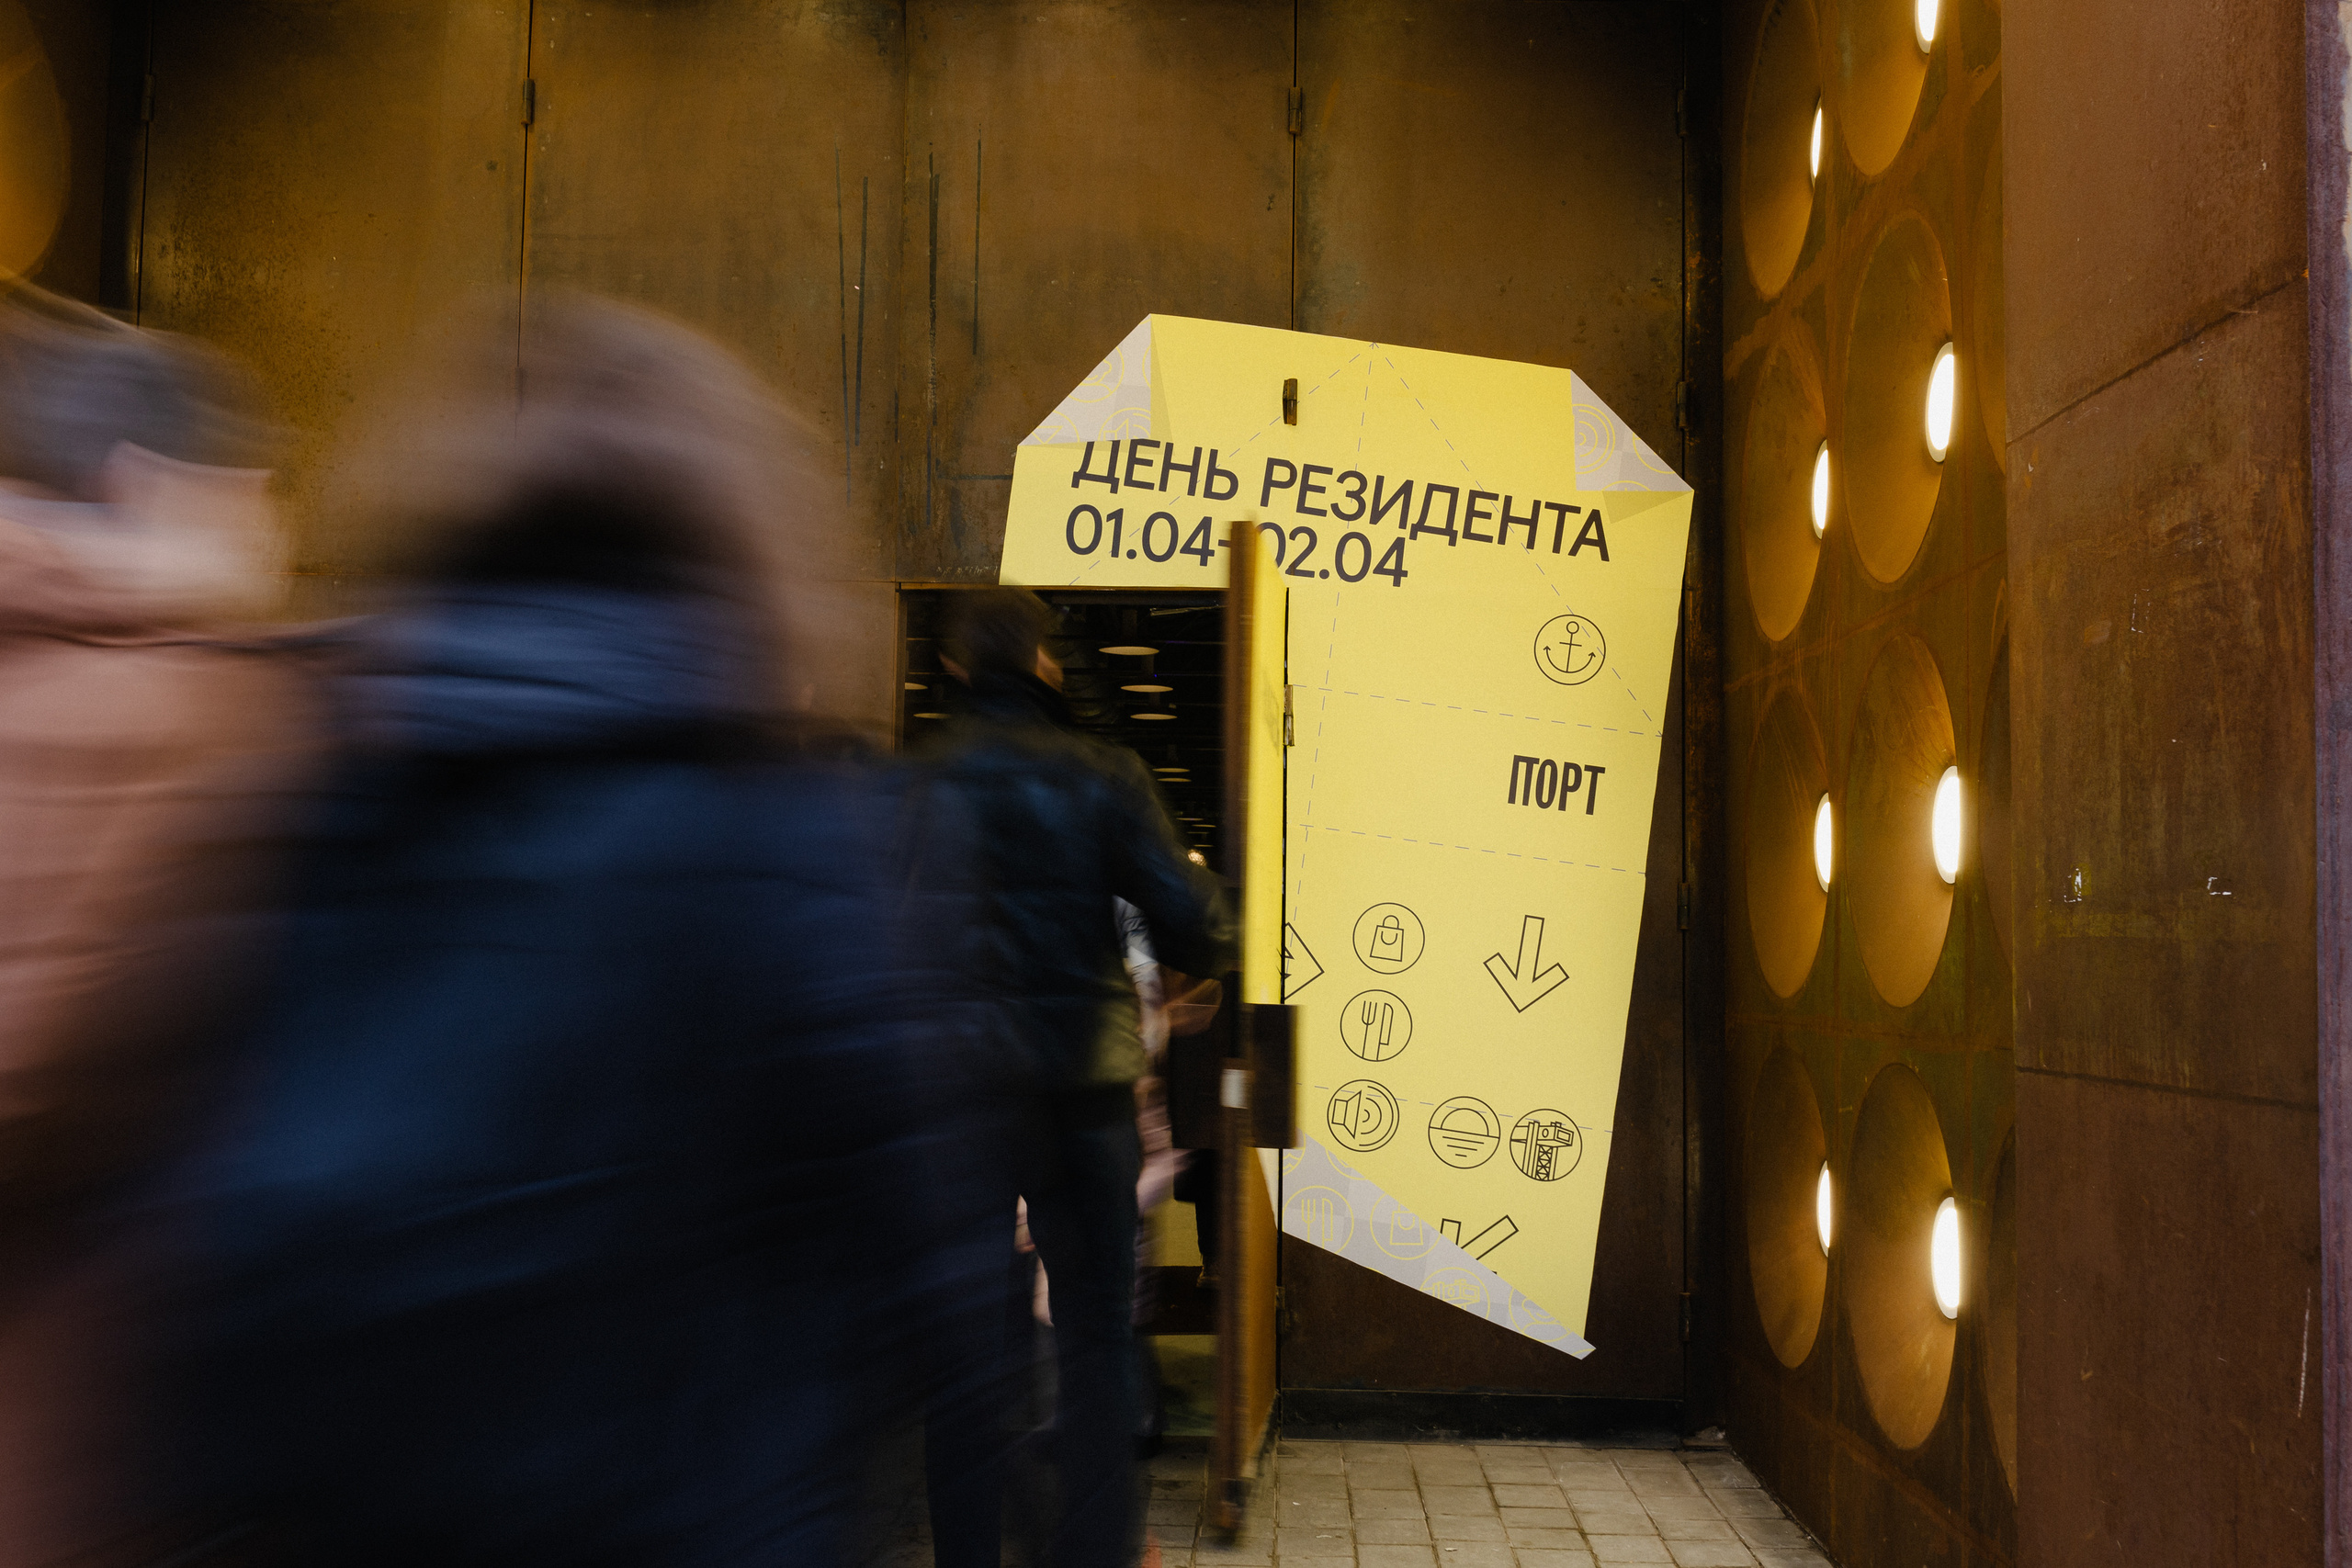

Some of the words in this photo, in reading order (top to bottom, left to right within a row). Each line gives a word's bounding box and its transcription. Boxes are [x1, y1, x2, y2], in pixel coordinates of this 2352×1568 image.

[1071, 438, 1238, 501] ДЕНЬ
[1260, 457, 1610, 562] РЕЗИДЕНТА
[1508, 754, 1606, 816] ПОРТ
